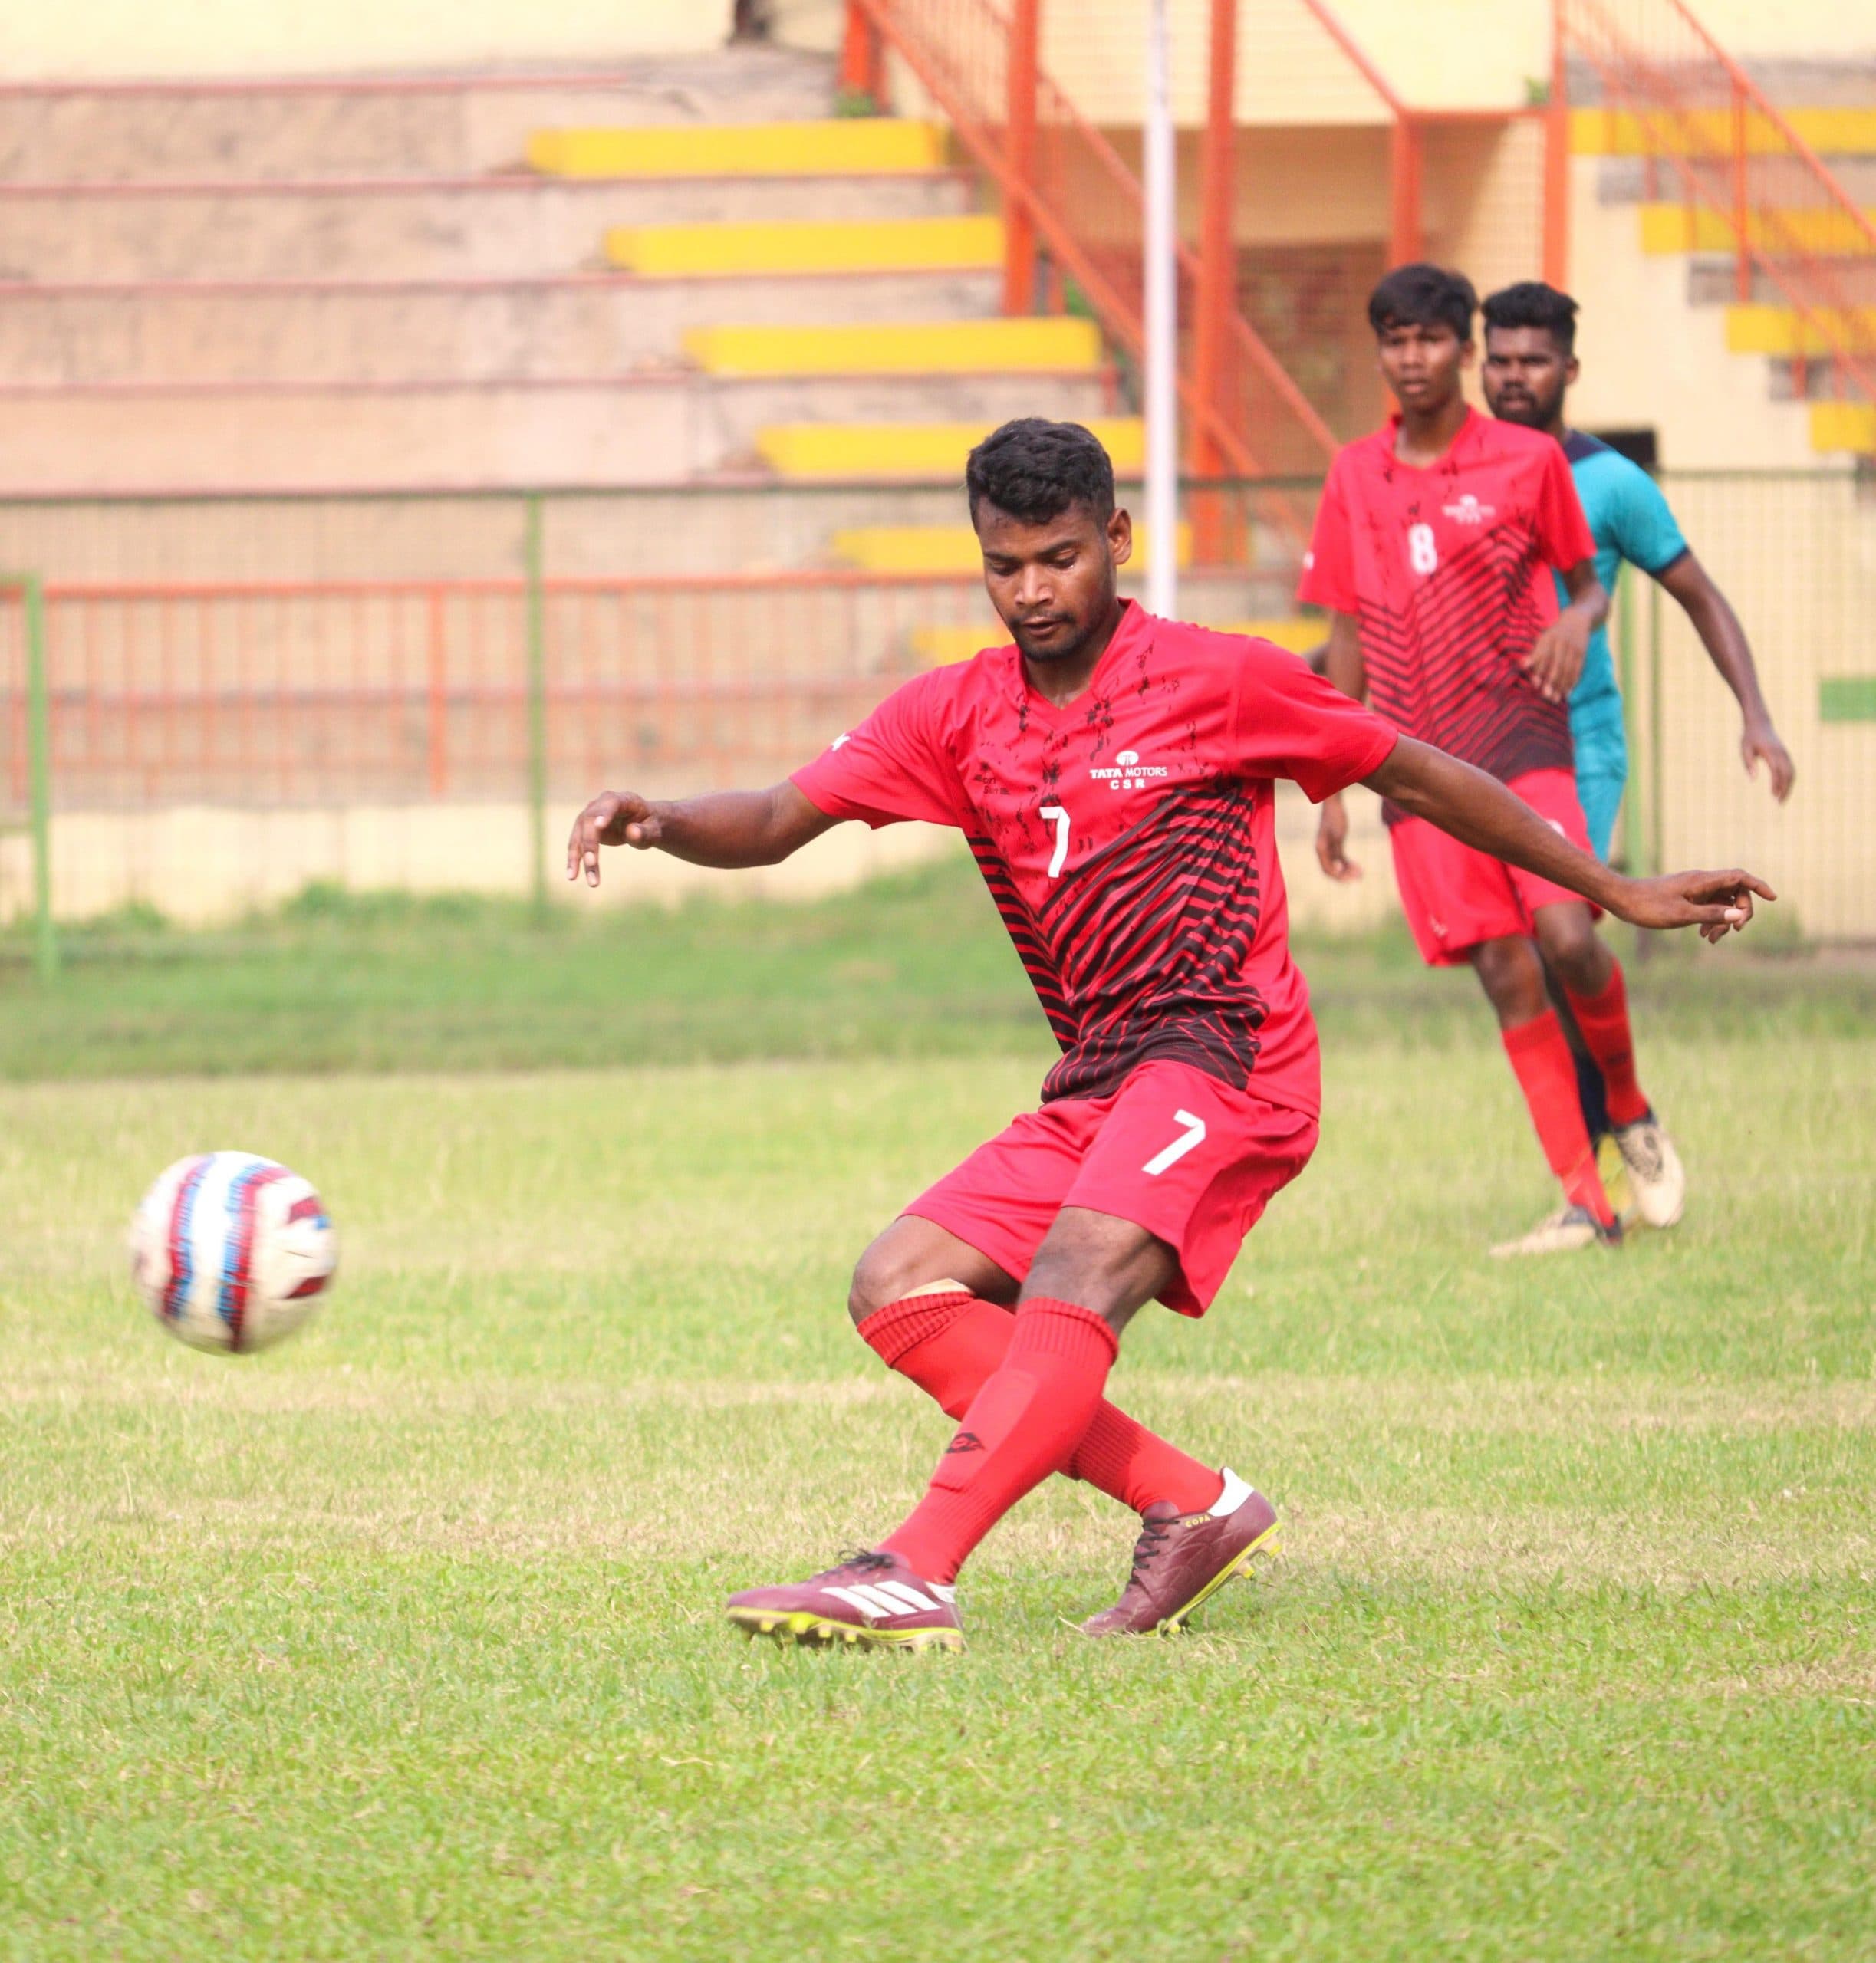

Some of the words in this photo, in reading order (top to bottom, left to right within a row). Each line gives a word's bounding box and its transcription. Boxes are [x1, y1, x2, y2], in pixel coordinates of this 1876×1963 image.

[1408, 523, 1437, 574] 8
[1090, 768, 1123, 778] TATA
[1125, 767, 1167, 777] MOTORS
[1038, 806, 1071, 877] 7
[1141, 1109, 1206, 1175] 7
[1186, 1514, 1210, 1527] COPA
